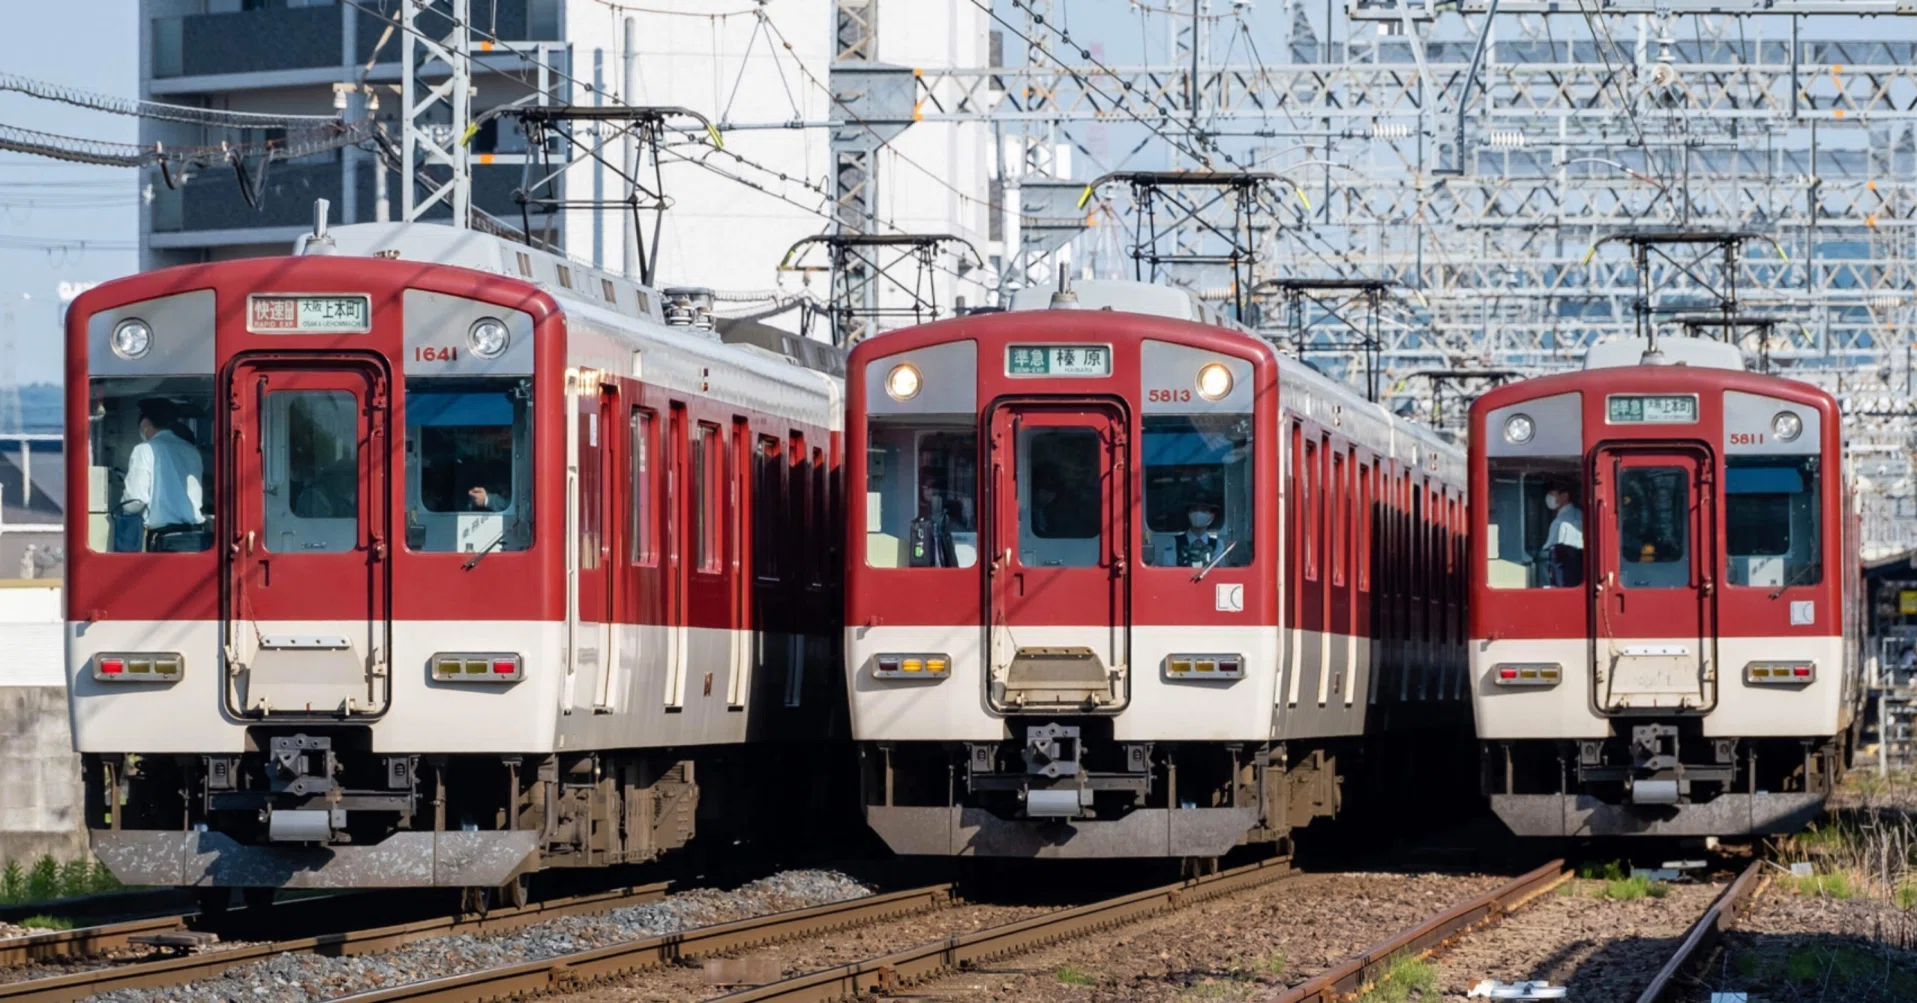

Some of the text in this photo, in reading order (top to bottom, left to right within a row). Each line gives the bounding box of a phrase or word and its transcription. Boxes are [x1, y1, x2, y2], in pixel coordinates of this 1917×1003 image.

[303, 299, 361, 319] 大阪上本町
[415, 346, 457, 362] 1641
[1014, 349, 1045, 366] 準急
[1057, 348, 1102, 367] 榛原
[1149, 389, 1191, 402] 5813
[1730, 433, 1764, 445] 5811
